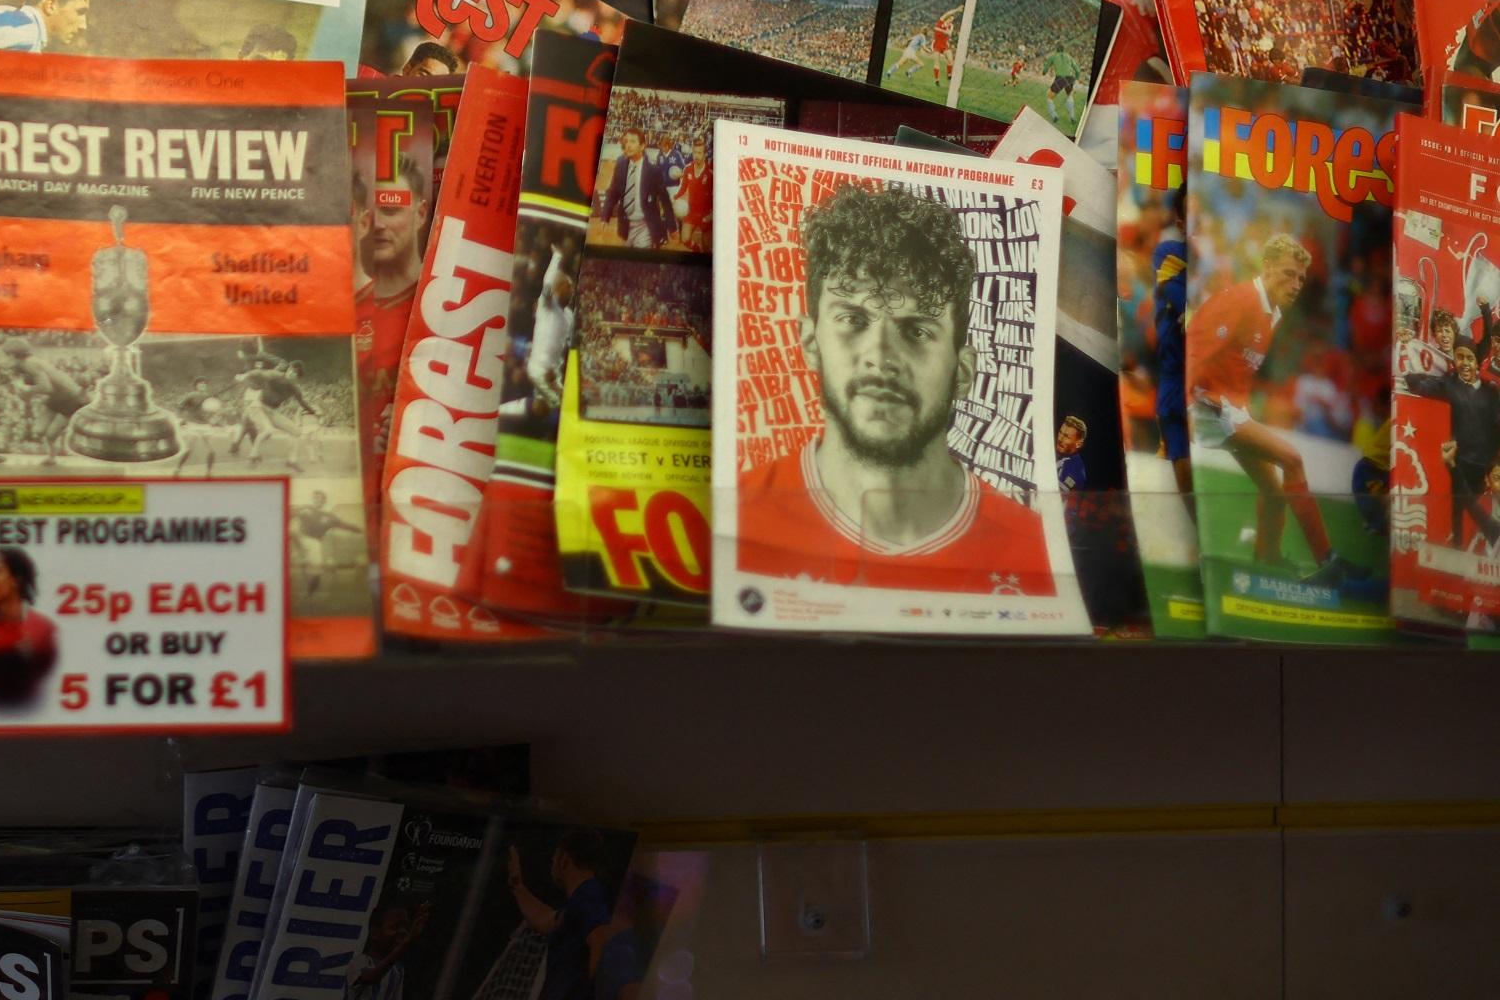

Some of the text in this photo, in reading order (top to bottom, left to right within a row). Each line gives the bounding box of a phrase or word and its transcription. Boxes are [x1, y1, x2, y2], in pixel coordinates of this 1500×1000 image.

[125, 129, 308, 181] REVIEW
[469, 113, 507, 207] EVERTON
[738, 135, 1044, 190] 13 NOTTINGHAM FOREST OFFICIAL MATCHDAY PROGRAMME £3
[44, 180, 72, 193] DAY
[77, 182, 150, 198] MAGAZINE
[192, 186, 220, 199] FIVE
[225, 187, 257, 199] NEW
[261, 187, 306, 200] PENCE
[379, 193, 402, 204] Club
[210, 251, 309, 275] Sheffield
[225, 282, 298, 306] United
[586, 449, 647, 466] FOREST
[57, 517, 247, 545] PROGRAMMES
[56, 583, 266, 621] 25p EACH
[105, 631, 226, 655] OR BUY
[59, 671, 267, 710] 5 FOR £1
[428, 834, 483, 849] FOUNDATION
